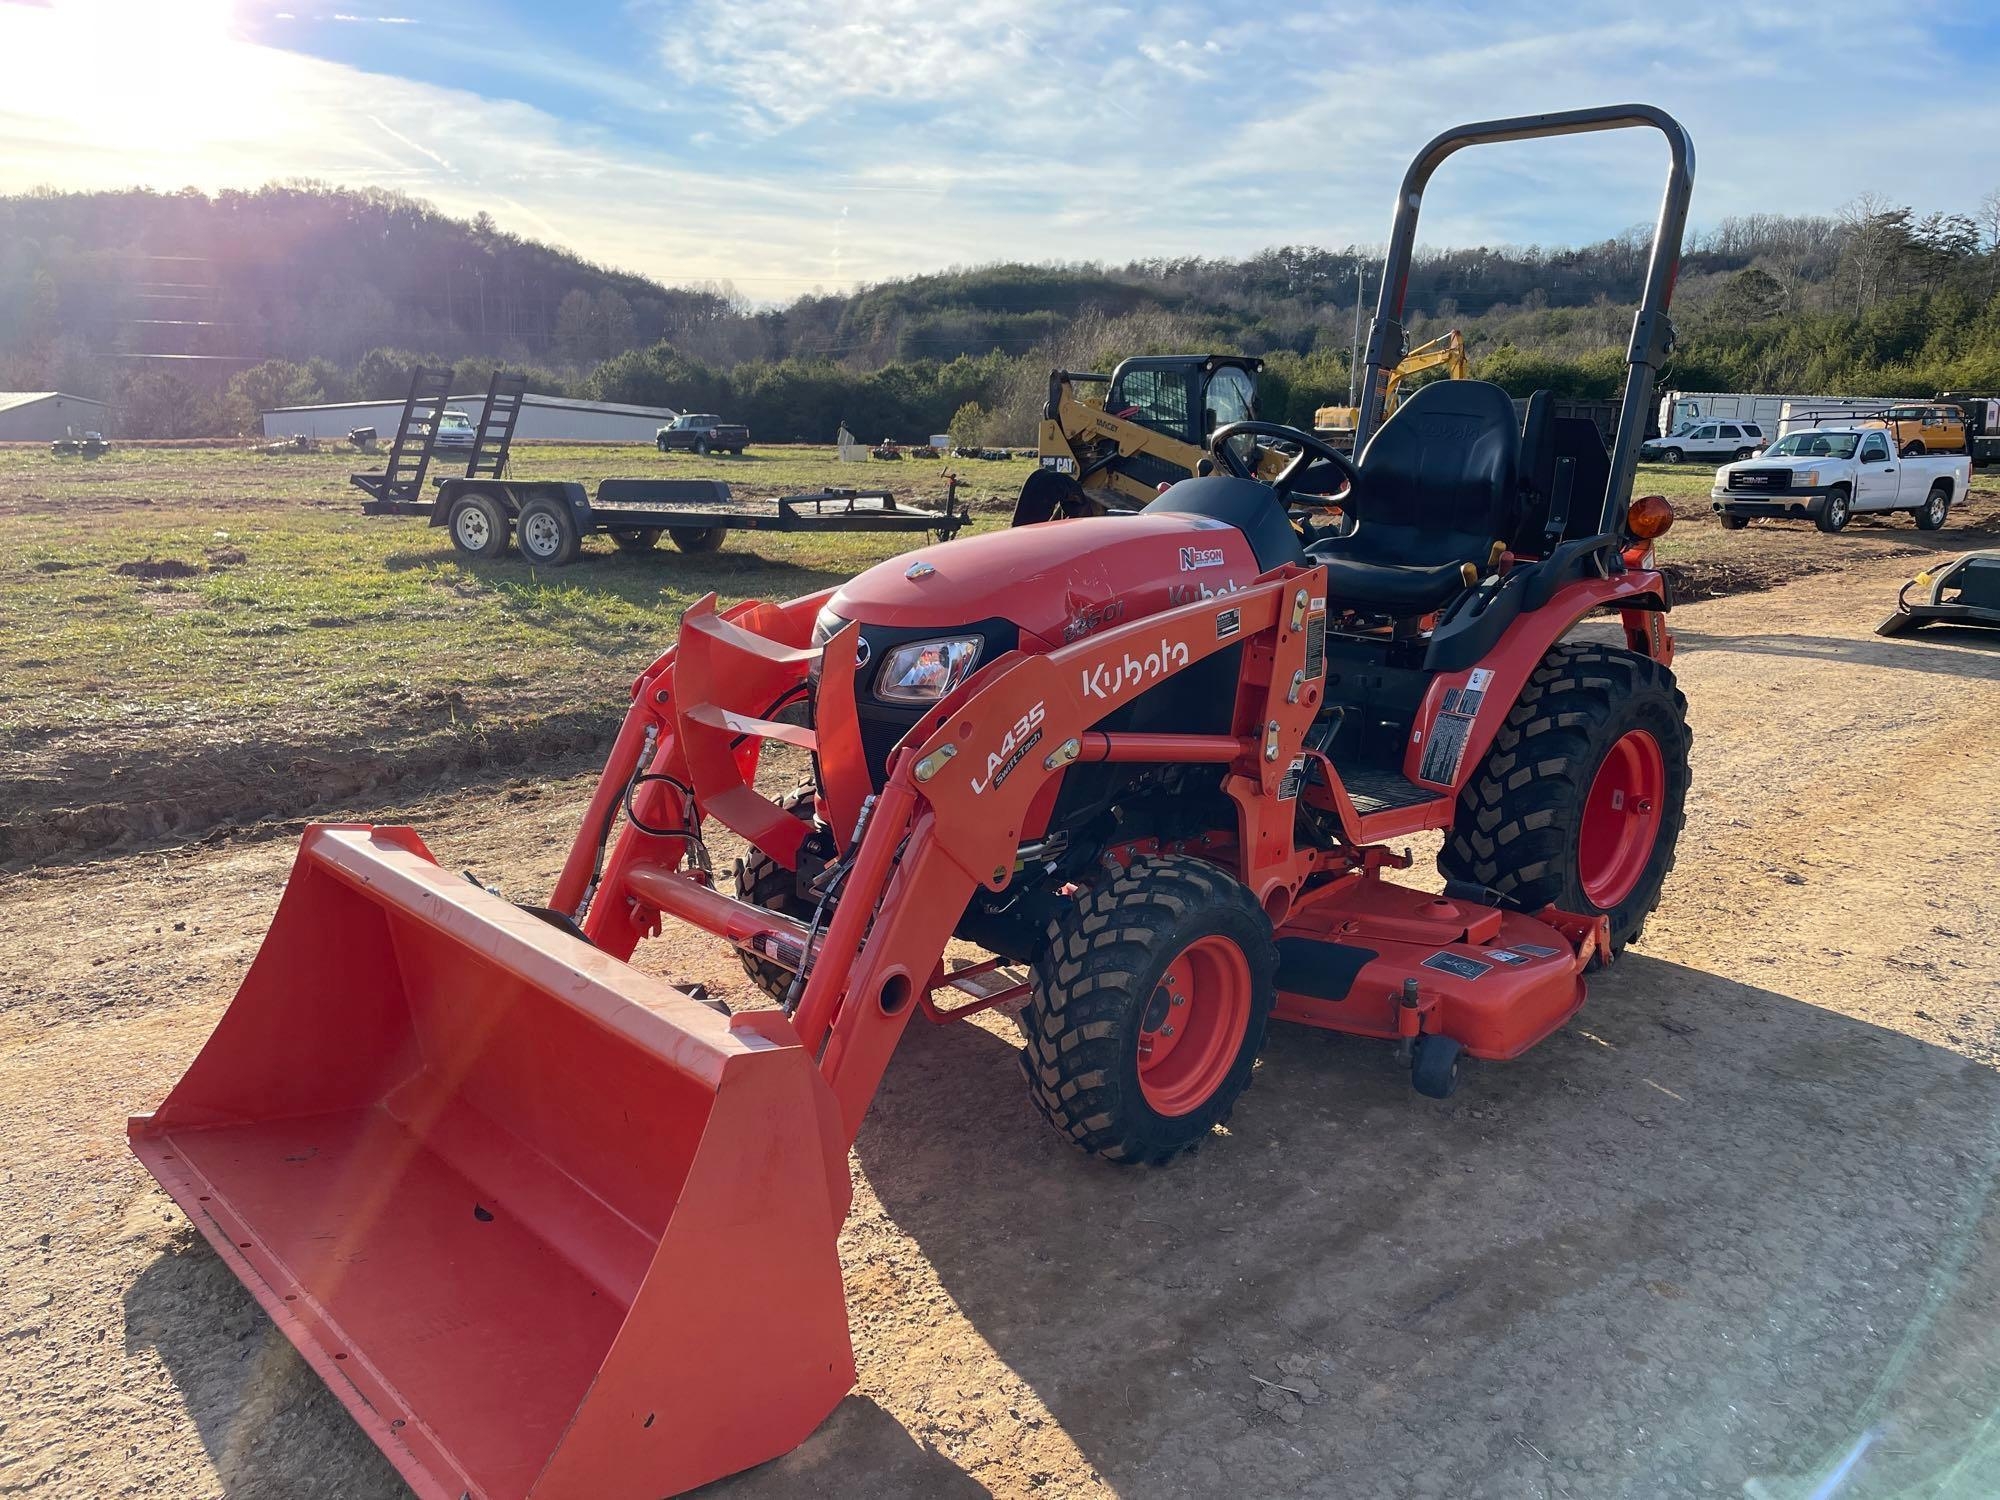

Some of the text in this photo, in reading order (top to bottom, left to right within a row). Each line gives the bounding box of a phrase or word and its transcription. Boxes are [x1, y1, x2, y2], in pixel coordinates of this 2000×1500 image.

[1056, 458, 1074, 473] CAT
[1180, 548, 1222, 569] NELSON
[1082, 639, 1189, 699] Kubota
[971, 700, 1045, 795] LA435
[994, 733, 1041, 787] Swift-Tach
